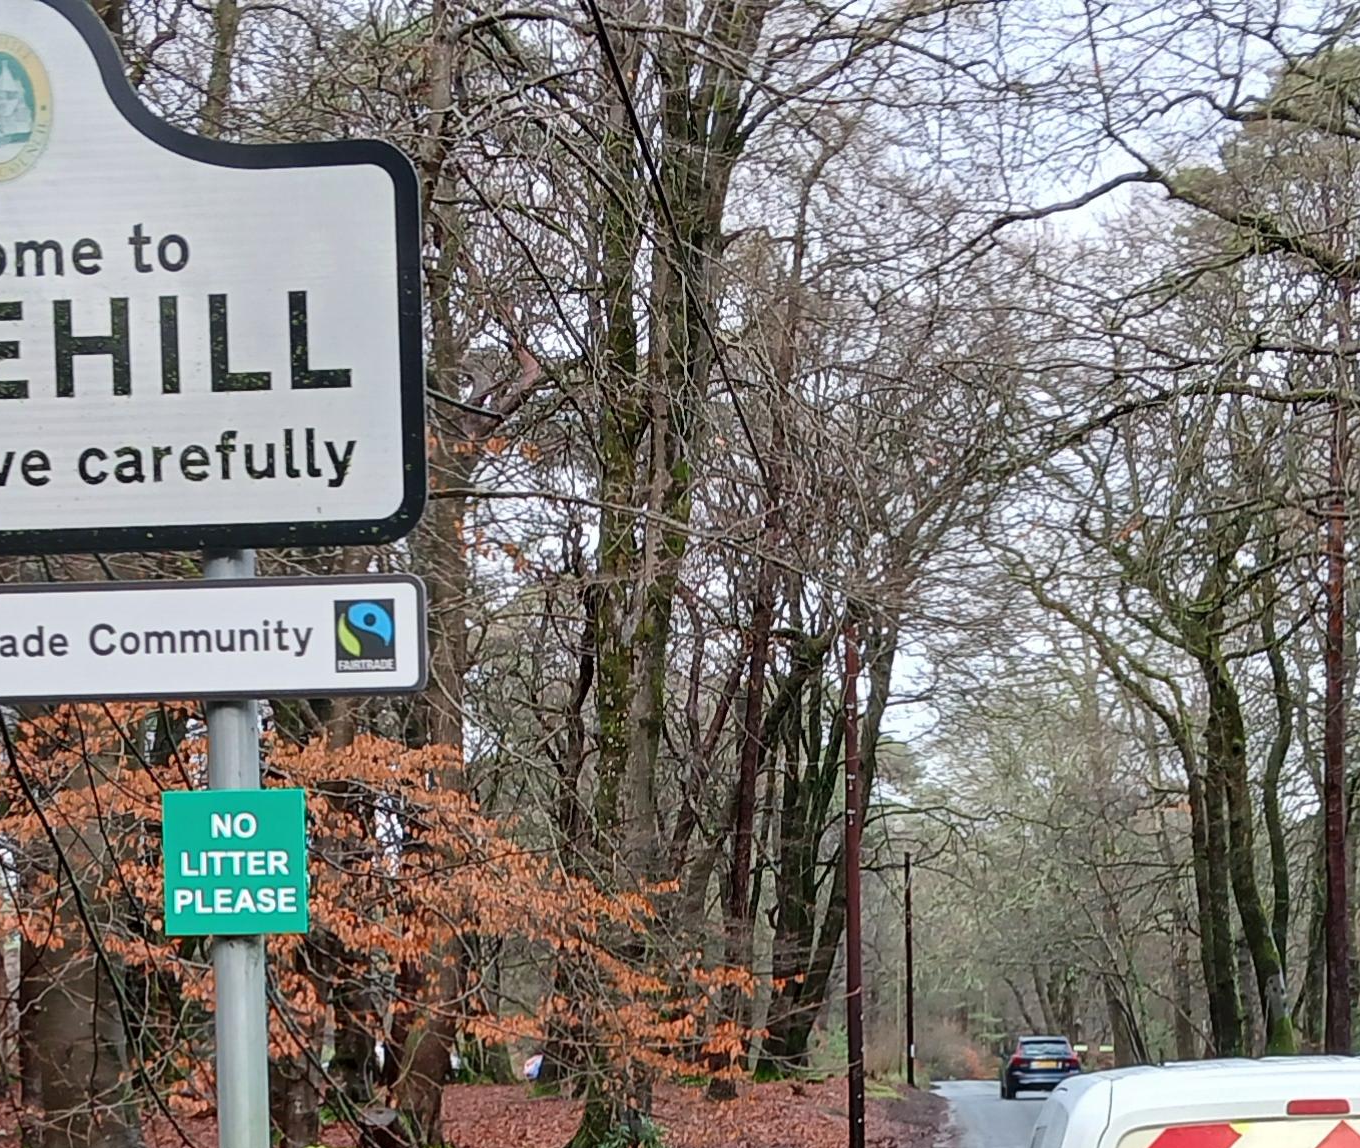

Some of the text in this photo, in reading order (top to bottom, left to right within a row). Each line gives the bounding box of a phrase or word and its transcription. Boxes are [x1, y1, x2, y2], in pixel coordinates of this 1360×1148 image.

[128, 223, 190, 274] to
[77, 427, 357, 488] carefully
[88, 619, 314, 658] Community
[337, 659, 395, 671] FAIRTRADE
[210, 812, 257, 839] NO
[180, 851, 289, 877] LITTER
[173, 887, 297, 915] PLEASE
